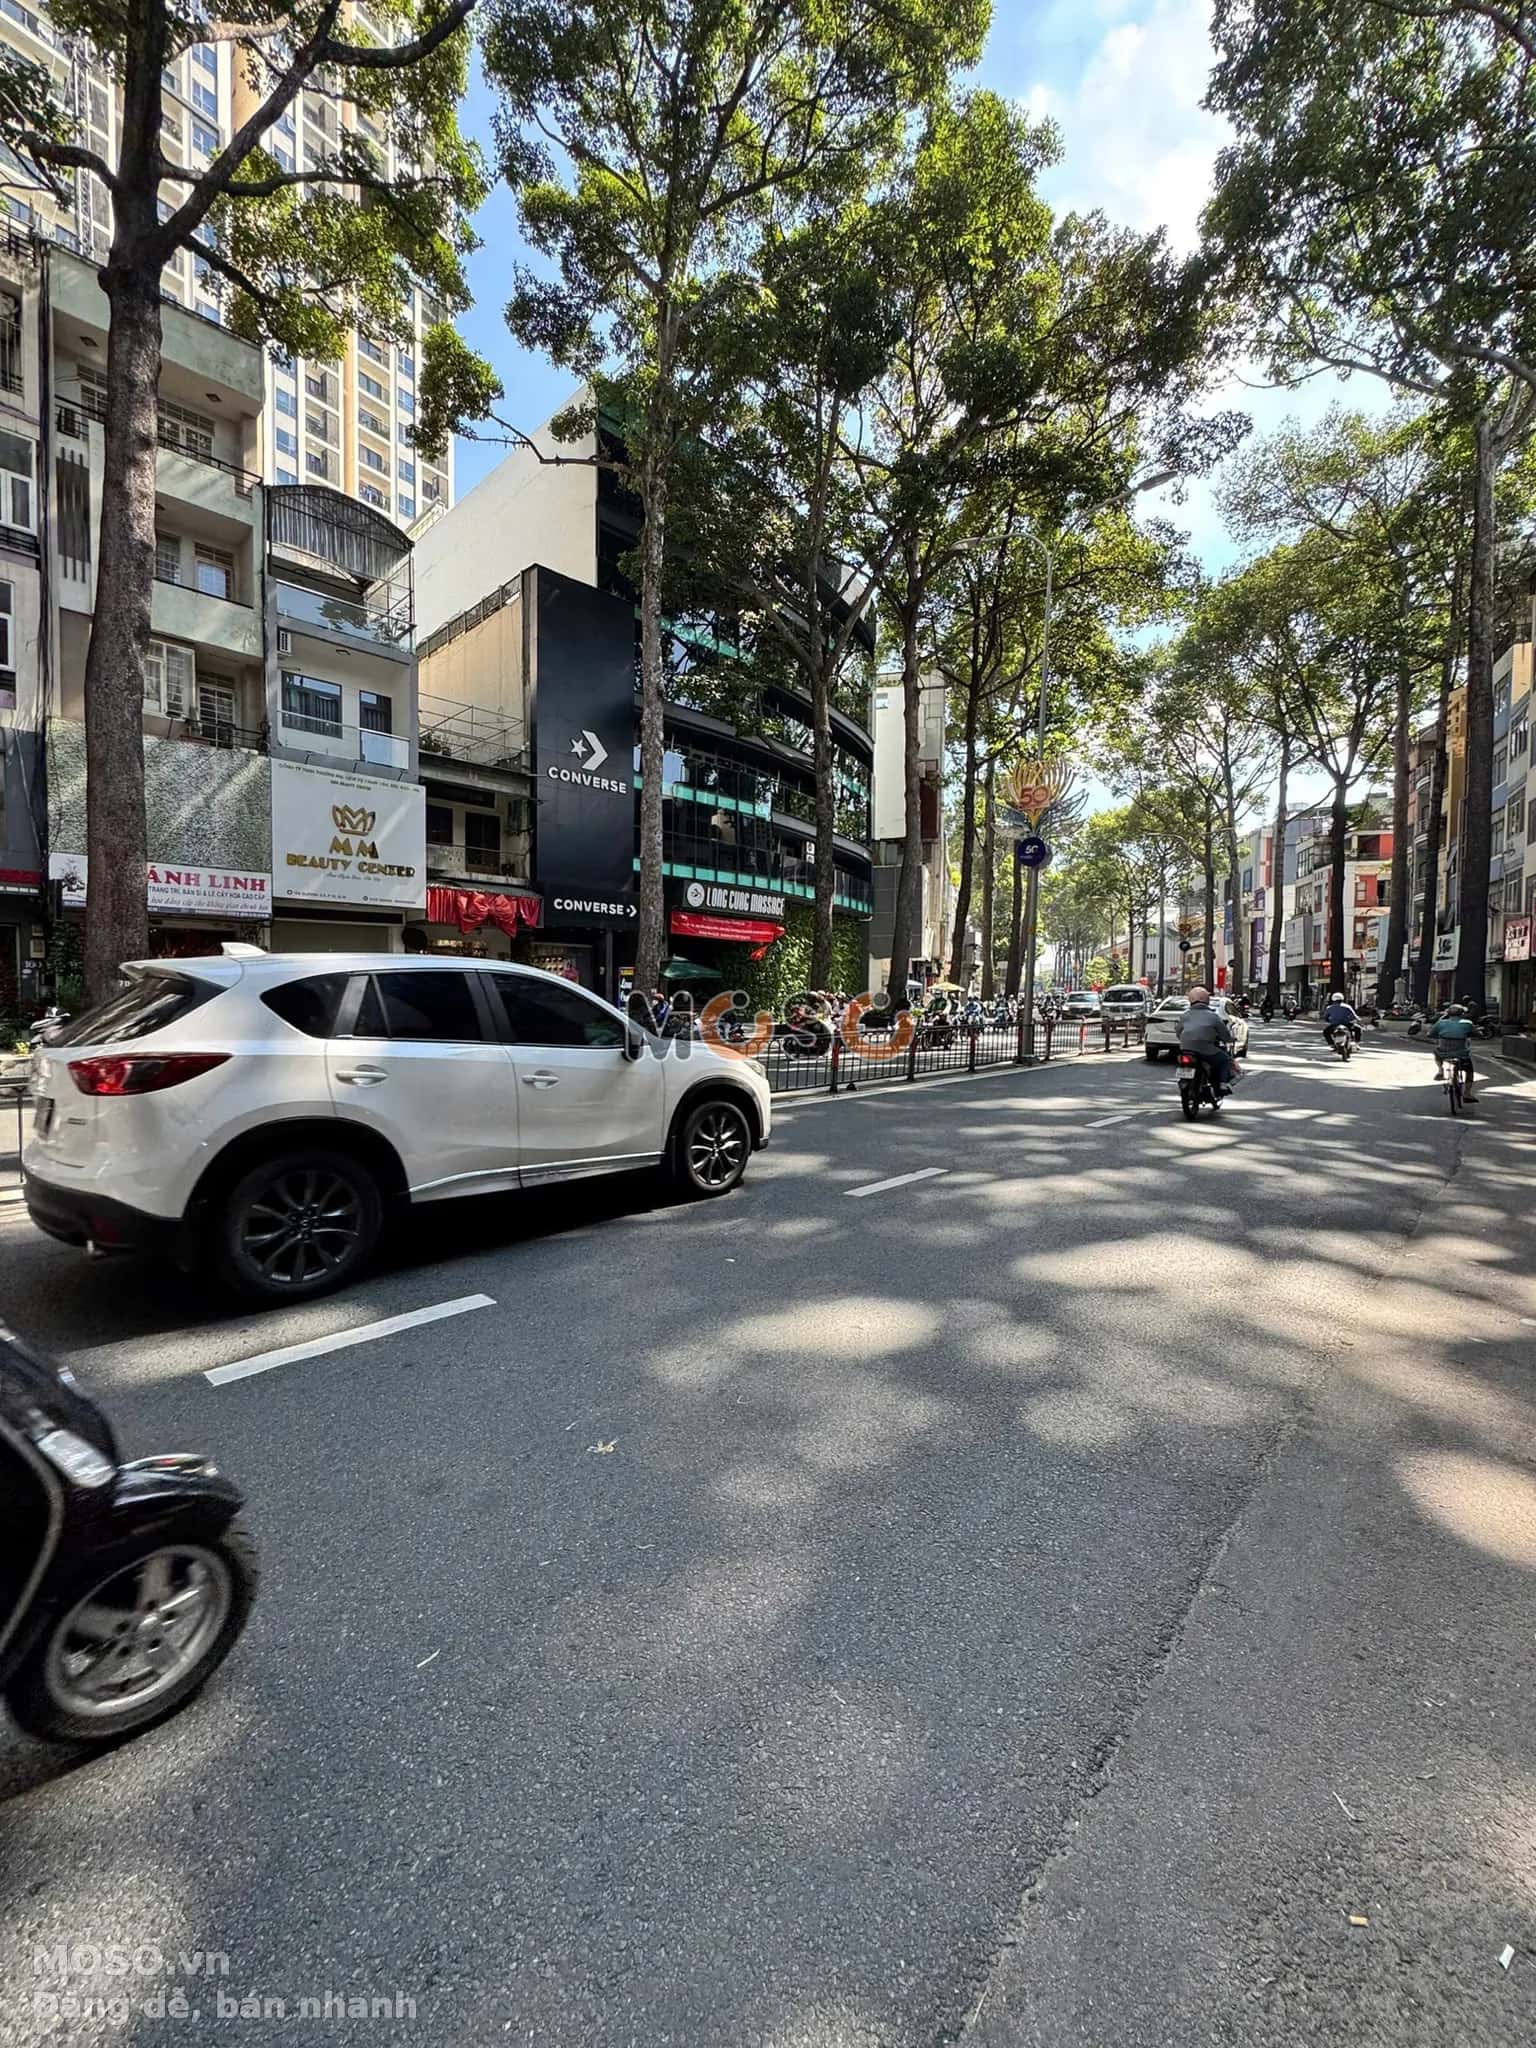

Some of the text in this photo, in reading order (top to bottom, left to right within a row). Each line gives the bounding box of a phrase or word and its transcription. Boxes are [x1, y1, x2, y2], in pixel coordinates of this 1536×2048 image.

[547, 765, 627, 793] CONVERSE
[286, 852, 353, 871] BEAUTY
[357, 861, 416, 878] CENTER
[208, 874, 265, 891] LINH
[553, 896, 624, 915] CONVERSE
[706, 887, 785, 916] LONG CUNG MASSAGE
